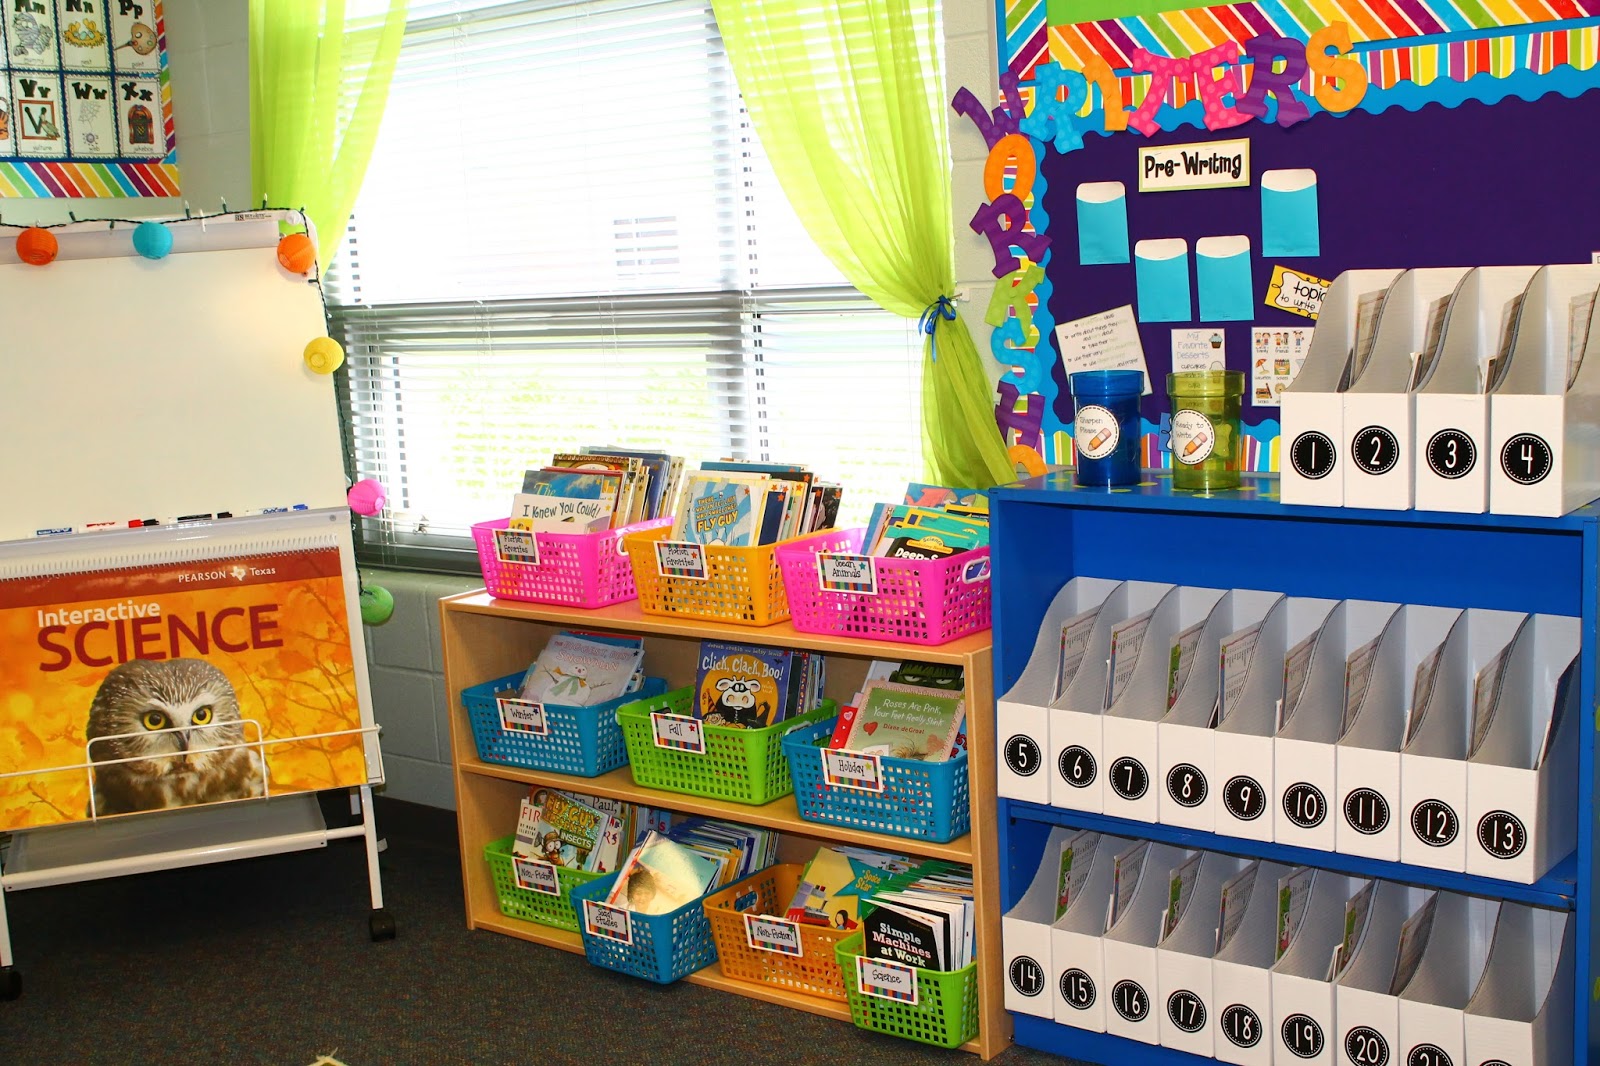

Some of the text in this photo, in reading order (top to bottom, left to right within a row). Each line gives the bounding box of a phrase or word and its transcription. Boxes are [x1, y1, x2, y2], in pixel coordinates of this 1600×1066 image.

[118, 0, 143, 19] Pp
[72, 82, 107, 100] Ww
[121, 82, 153, 101] Xx
[951, 20, 1368, 154] WRITERS
[1144, 151, 1242, 179] Pre-Writing
[1281, 294, 1316, 311] to write
[1177, 351, 1209, 359] Desserts
[1176, 420, 1193, 429] Ready
[1369, 436, 1382, 465] 2
[1445, 440, 1457, 468] 3
[1520, 444, 1534, 474] 4
[522, 501, 602, 519] I Knew You Could!
[696, 510, 738, 533] FLY GUY
[178, 567, 276, 583] PEARSON Texas
[832, 569, 861, 578] Animals
[835, 560, 856, 570] Ocean
[37, 599, 161, 628] Interactive
[37, 604, 284, 672] SCIENCE
[556, 650, 619, 671] SNOWMAN
[702, 651, 784, 680] Click, Clack, Boo!
[510, 708, 534, 721] Winter
[873, 706, 945, 727] Your Feet Really Stink
[882, 698, 942, 715] Roses Are Pink,
[668, 724, 683, 736] Fall
[883, 723, 899, 731] Diane
[1018, 743, 1028, 768] 5
[1074, 755, 1082, 779] 6
[838, 759, 865, 777] Holiday
[1123, 766, 1133, 791] 7
[1182, 773, 1194, 798] 8
[592, 797, 617, 814] Paul,
[1240, 785, 1252, 812] 9
[1296, 791, 1318, 820] 10
[546, 794, 569, 815] FLY
[568, 806, 597, 829] GUY
[1358, 796, 1376, 826] 11
[1426, 808, 1447, 839] 12
[1493, 820, 1514, 850] 13
[560, 832, 592, 848] INSECTS
[855, 877, 872, 892] Star
[872, 931, 932, 959] Machines
[879, 922, 922, 945] Simple
[880, 945, 926, 967] at Work
[871, 969, 902, 984] Science
[1020, 963, 1037, 990] 14
[1070, 976, 1087, 1002] 15
[1124, 988, 1140, 1015] 16
[1180, 998, 1197, 1025] 17
[1234, 1013, 1253, 1040] 18
[1294, 1023, 1314, 1051] 19
[1356, 1034, 1379, 1062] 20
